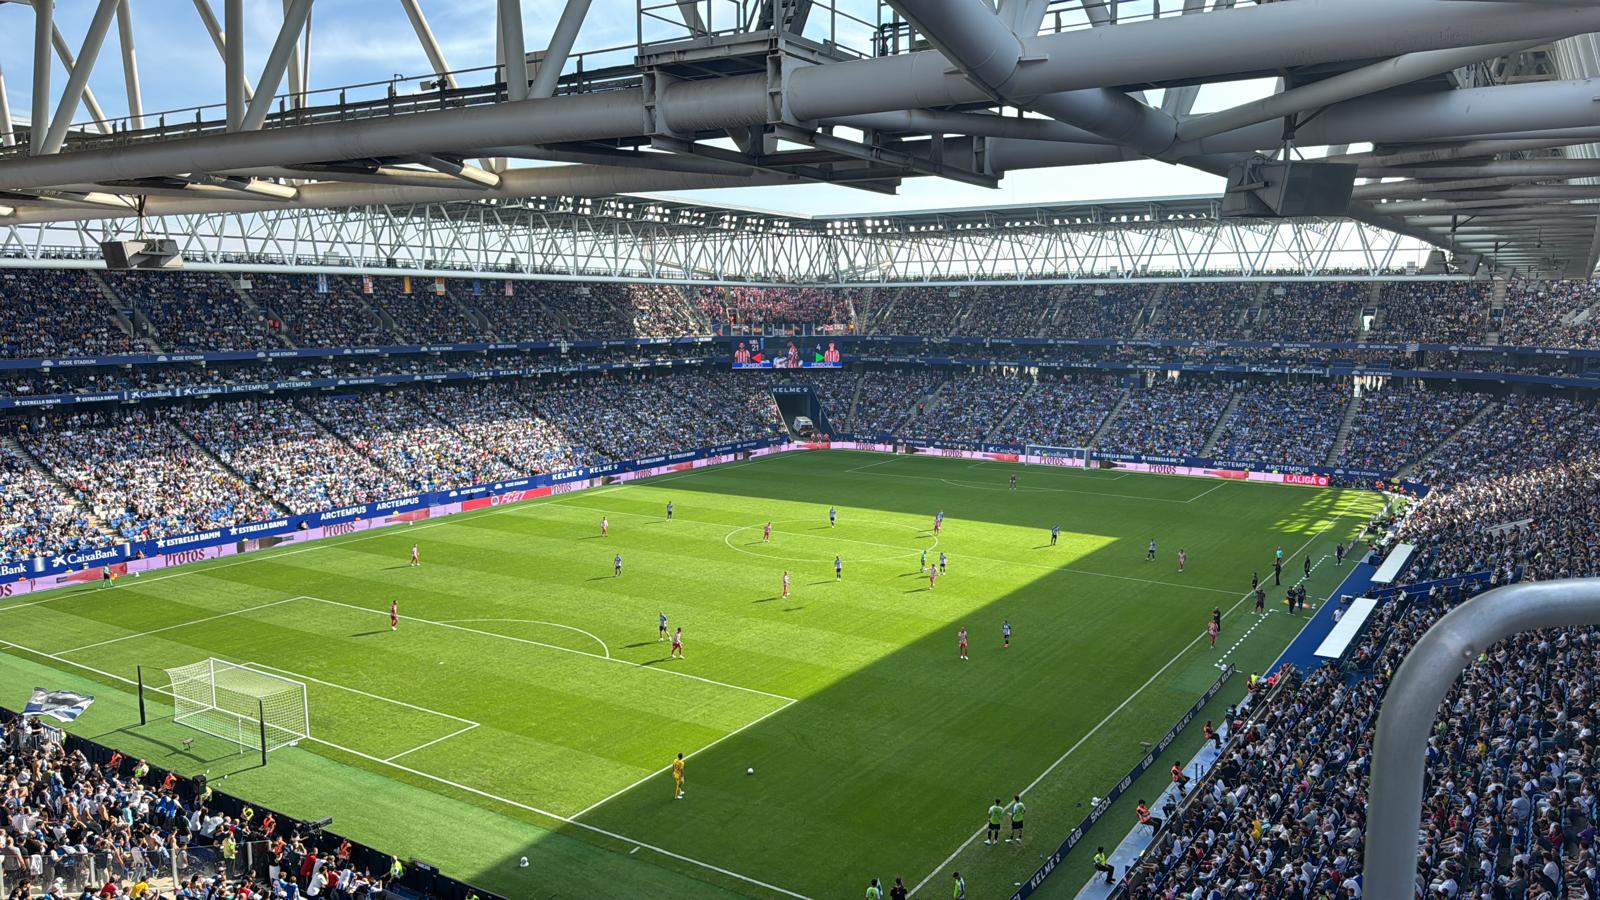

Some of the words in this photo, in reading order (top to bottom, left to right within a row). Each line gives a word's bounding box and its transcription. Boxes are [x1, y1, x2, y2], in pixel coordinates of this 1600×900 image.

[140, 390, 172, 398] CaixaBank
[232, 384, 269, 392] ARCTEMPUS
[589, 465, 613, 474] KELME
[1149, 464, 1176, 474] Protos
[1213, 461, 1255, 469] ARCTEMPUS
[1266, 464, 1309, 473] ARCTEMPUS
[552, 471, 577, 480] KELME
[1287, 475, 1316, 484] LALIGA
[376, 497, 419, 511] ARCTEMPUS
[500, 492, 526, 504] FC27
[320, 506, 367, 520] ARCTEMPUS
[238, 524, 268, 534] ESTRELLA
[269, 520, 288, 529] DAMM
[167, 535, 199, 546] ESTRELLA
[200, 531, 221, 541] DAMM
[67, 548, 118, 564] CaixaBank
[1119, 776, 1132, 793] LALIGA
[1068, 828, 1083, 848] LALIGA
[1030, 858, 1055, 890] KELME
